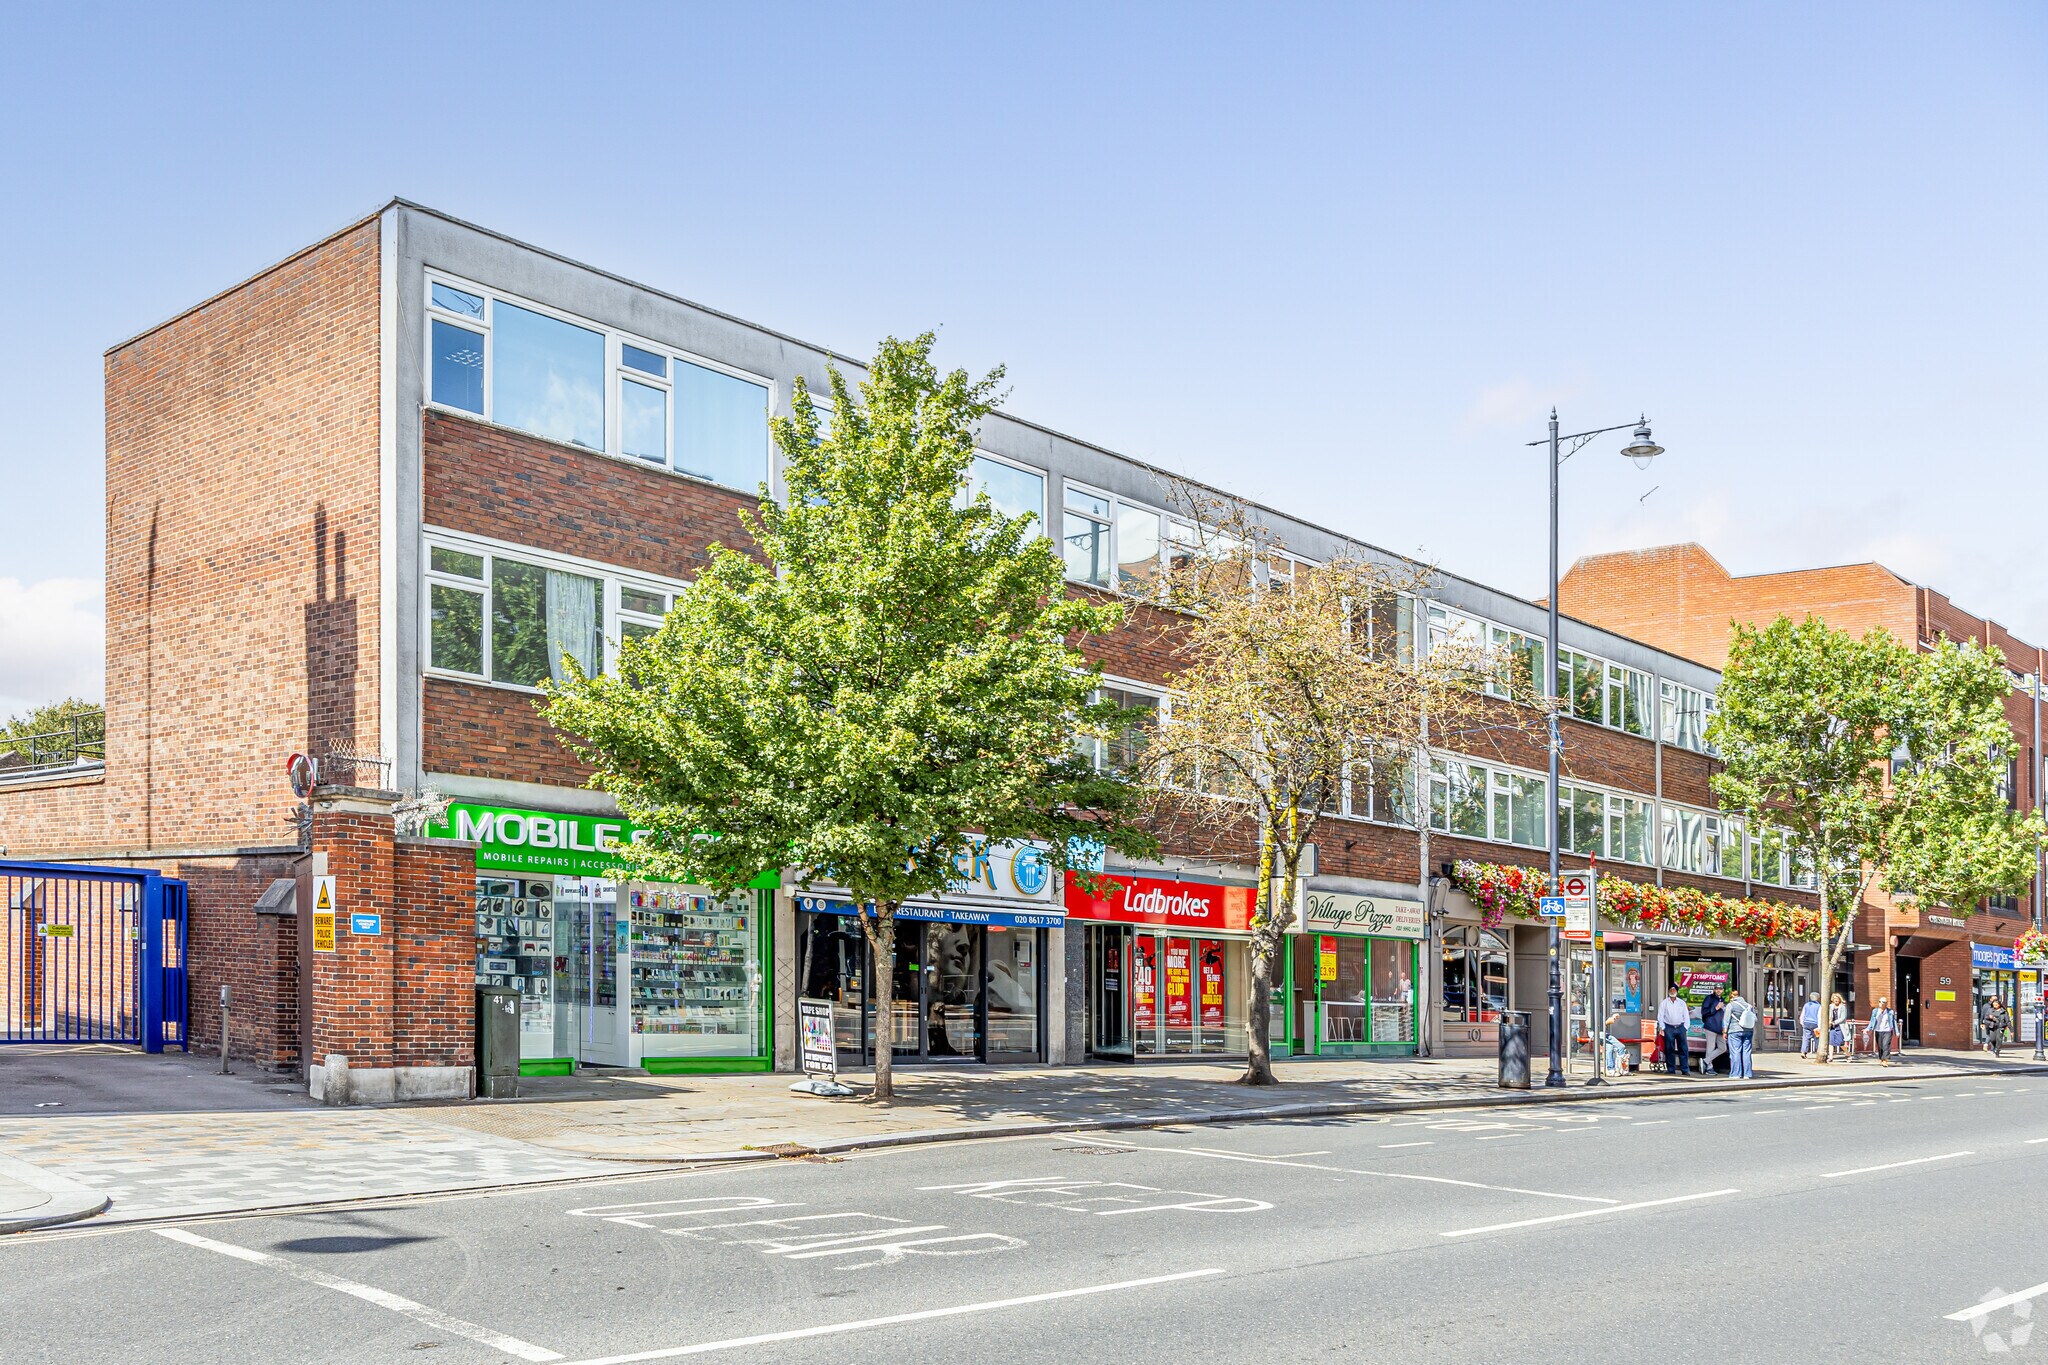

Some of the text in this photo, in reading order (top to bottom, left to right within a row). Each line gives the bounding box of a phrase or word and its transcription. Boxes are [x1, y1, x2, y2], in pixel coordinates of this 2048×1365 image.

[456, 809, 621, 853] MOBILE
[483, 852, 523, 863] MOBILE
[527, 855, 569, 867] REPAIRS
[1124, 885, 1210, 918] Ladbrokes
[896, 907, 990, 922] RESTAURANT TAKEAWAY
[1014, 915, 1062, 926] 020 8617 3700
[1307, 895, 1352, 930] Village
[1354, 900, 1394, 933] Pizza
[317, 929, 331, 938] POLICE
[315, 939, 333, 949] VEHICLES
[1167, 955, 1186, 969] MORE
[1993, 952, 2008, 966] cycles
[1320, 966, 1335, 977] £3.99
[1681, 973, 1726, 986] 7 SYMPTOMS
[1939, 976, 1952, 985] 59
[1167, 983, 1185, 996] CLUB
[1206, 981, 1219, 995] BET
[493, 995, 503, 1004] 41
[1202, 994, 1222, 1005] BUILDER
[815, 1006, 830, 1016] SHOP
[806, 1060, 821, 1070] FOR
[914, 1176, 1276, 1216] KEEP
[565, 1196, 1029, 1271] CLEAR
